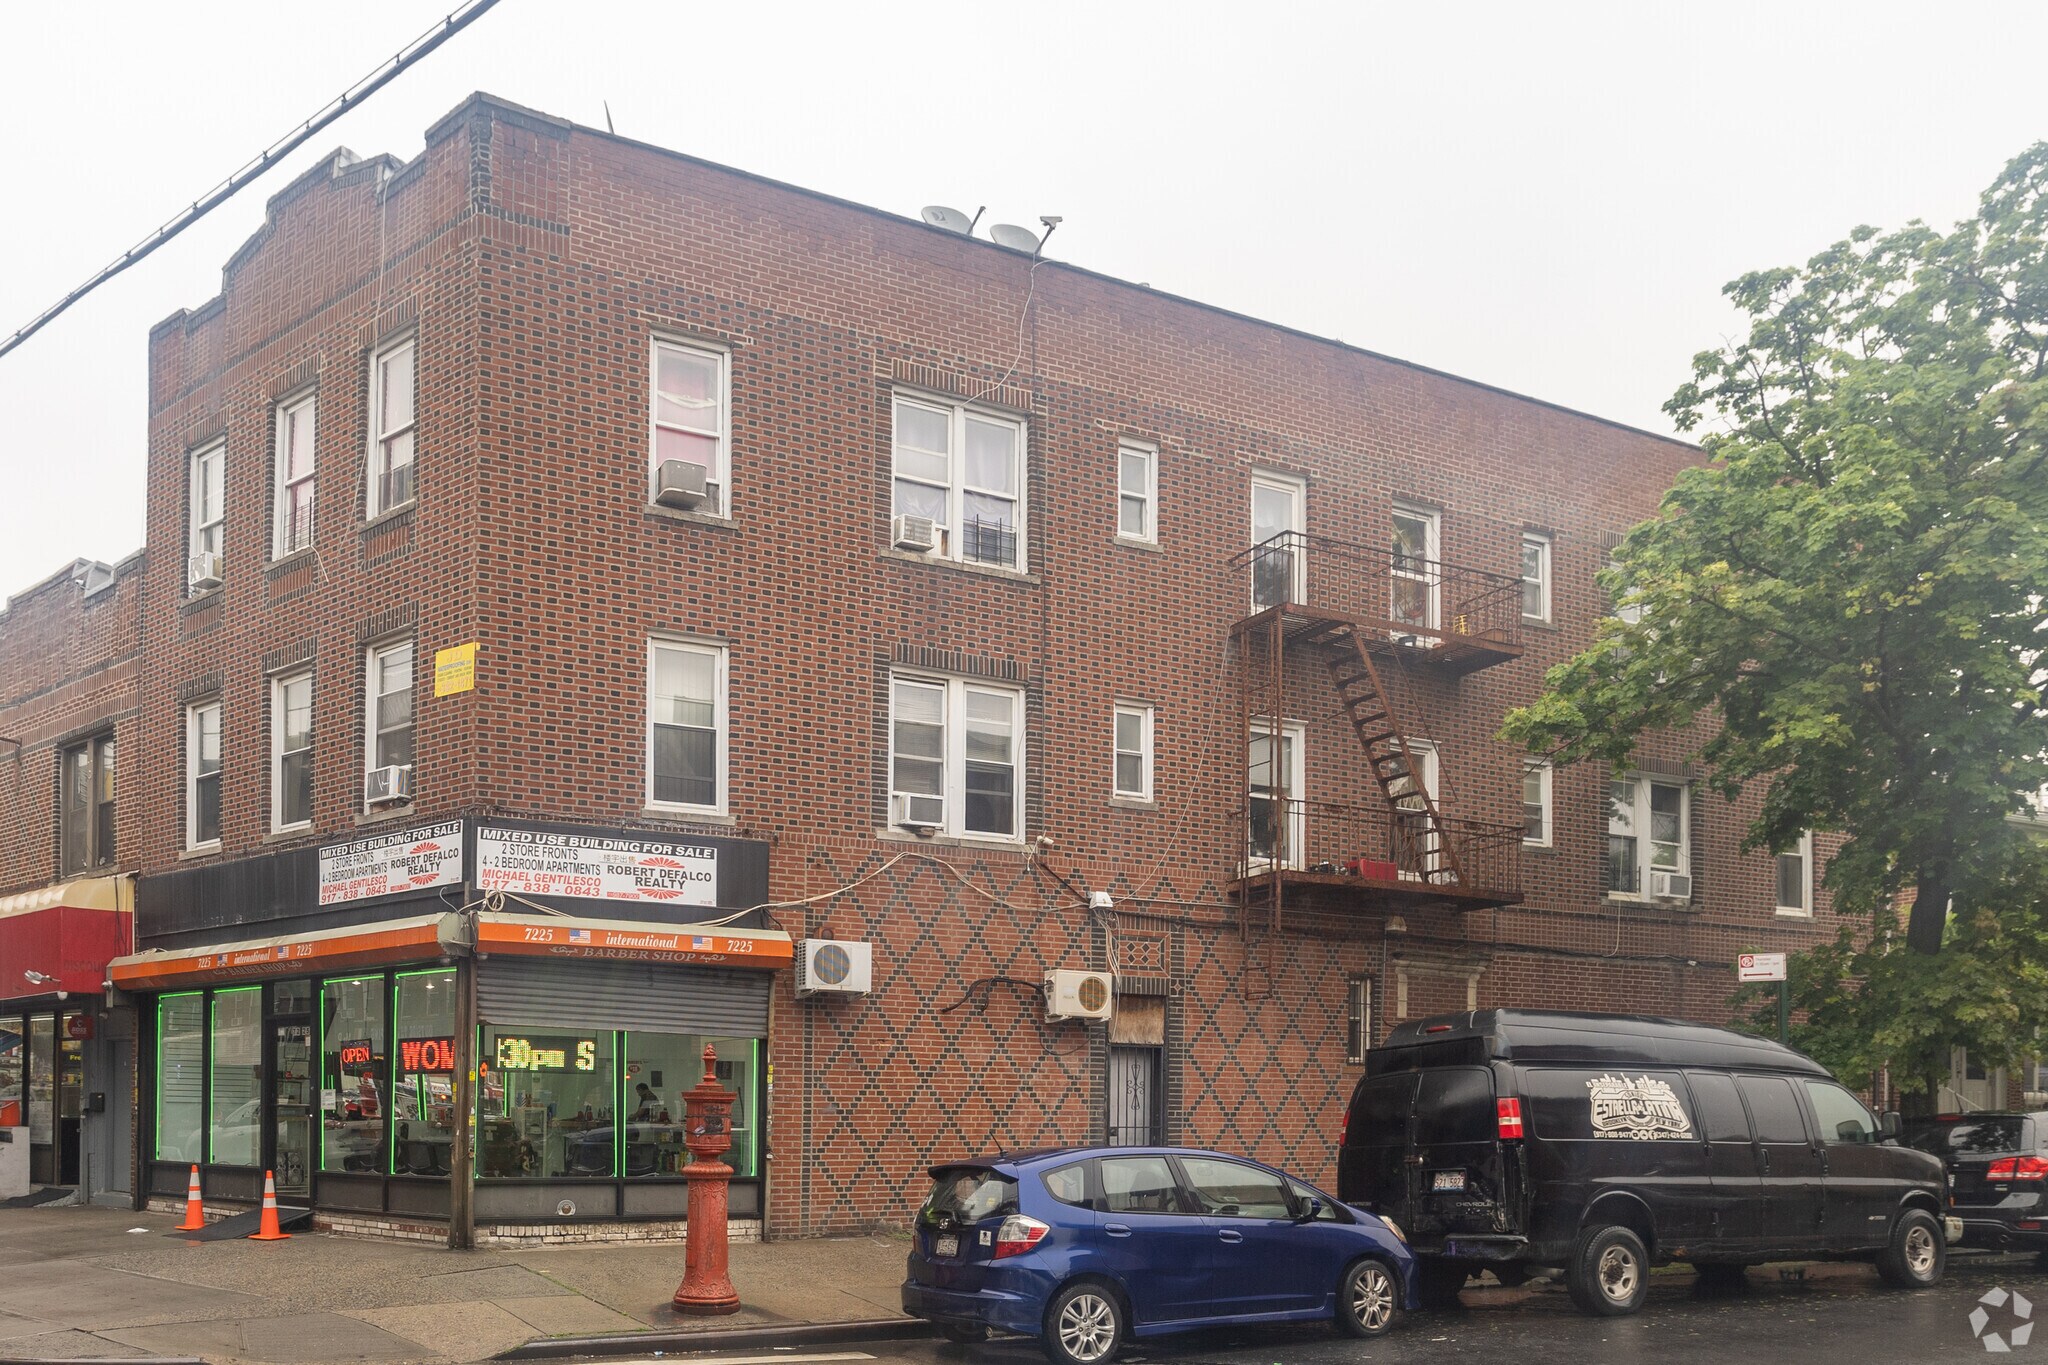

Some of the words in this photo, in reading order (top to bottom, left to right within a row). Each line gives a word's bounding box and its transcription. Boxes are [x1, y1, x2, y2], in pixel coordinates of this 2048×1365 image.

[321, 846, 348, 859] MIXED
[349, 842, 367, 854] USE
[368, 833, 411, 850] BUILDING
[412, 829, 432, 842] FOR
[433, 823, 460, 837] SALE
[482, 829, 532, 843] MIXED
[535, 835, 566, 846] USE
[569, 837, 640, 852] BUILDING
[642, 844, 672, 855] FOR
[675, 847, 712, 858] SALE
[390, 855, 421, 869] ROBERT
[423, 848, 459, 864] DEFALCO
[502, 843, 507, 854] 2
[509, 844, 539, 857] STORE
[542, 847, 578, 860] FRONTS
[335, 855, 352, 869] STORE
[353, 852, 374, 866] FRONTS
[407, 860, 441, 876] REALTY
[483, 855, 487, 866] 4
[494, 856, 499, 868] 2
[502, 857, 544, 871] BEDROOM
[546, 861, 600, 876] APARTMENTS
[332, 868, 355, 882] BEDROOM
[356, 862, 387, 876] APARTMENTS
[482, 869, 531, 882] MICHAEL
[534, 873, 601, 887] GENTILESCO
[607, 865, 655, 877] ROBERT
[659, 869, 712, 882] DEFALCO
[321, 882, 348, 894] MICHAEL
[349, 875, 387, 889] GENTILESCO
[481, 879, 510, 889] 917
[523, 882, 551, 893] 838
[564, 885, 600, 897] 0843
[635, 876, 686, 890] REALTY
[321, 893, 336, 904] 917
[343, 889, 358, 899] 838
[366, 885, 387, 896] 0843
[524, 928, 553, 942] 7225
[605, 932, 678, 949] international
[296, 944, 312, 957] 7225
[582, 947, 649, 959] BARBER
[651, 950, 696, 961] SHOP
[727, 939, 753, 953] 7225
[233, 948, 271, 965] international
[228, 966, 261, 976] BARBER
[262, 962, 286, 973] SHOP
[342, 1047, 370, 1063] OPEN
[1596, 1100, 1640, 1117] ESTRELLA
